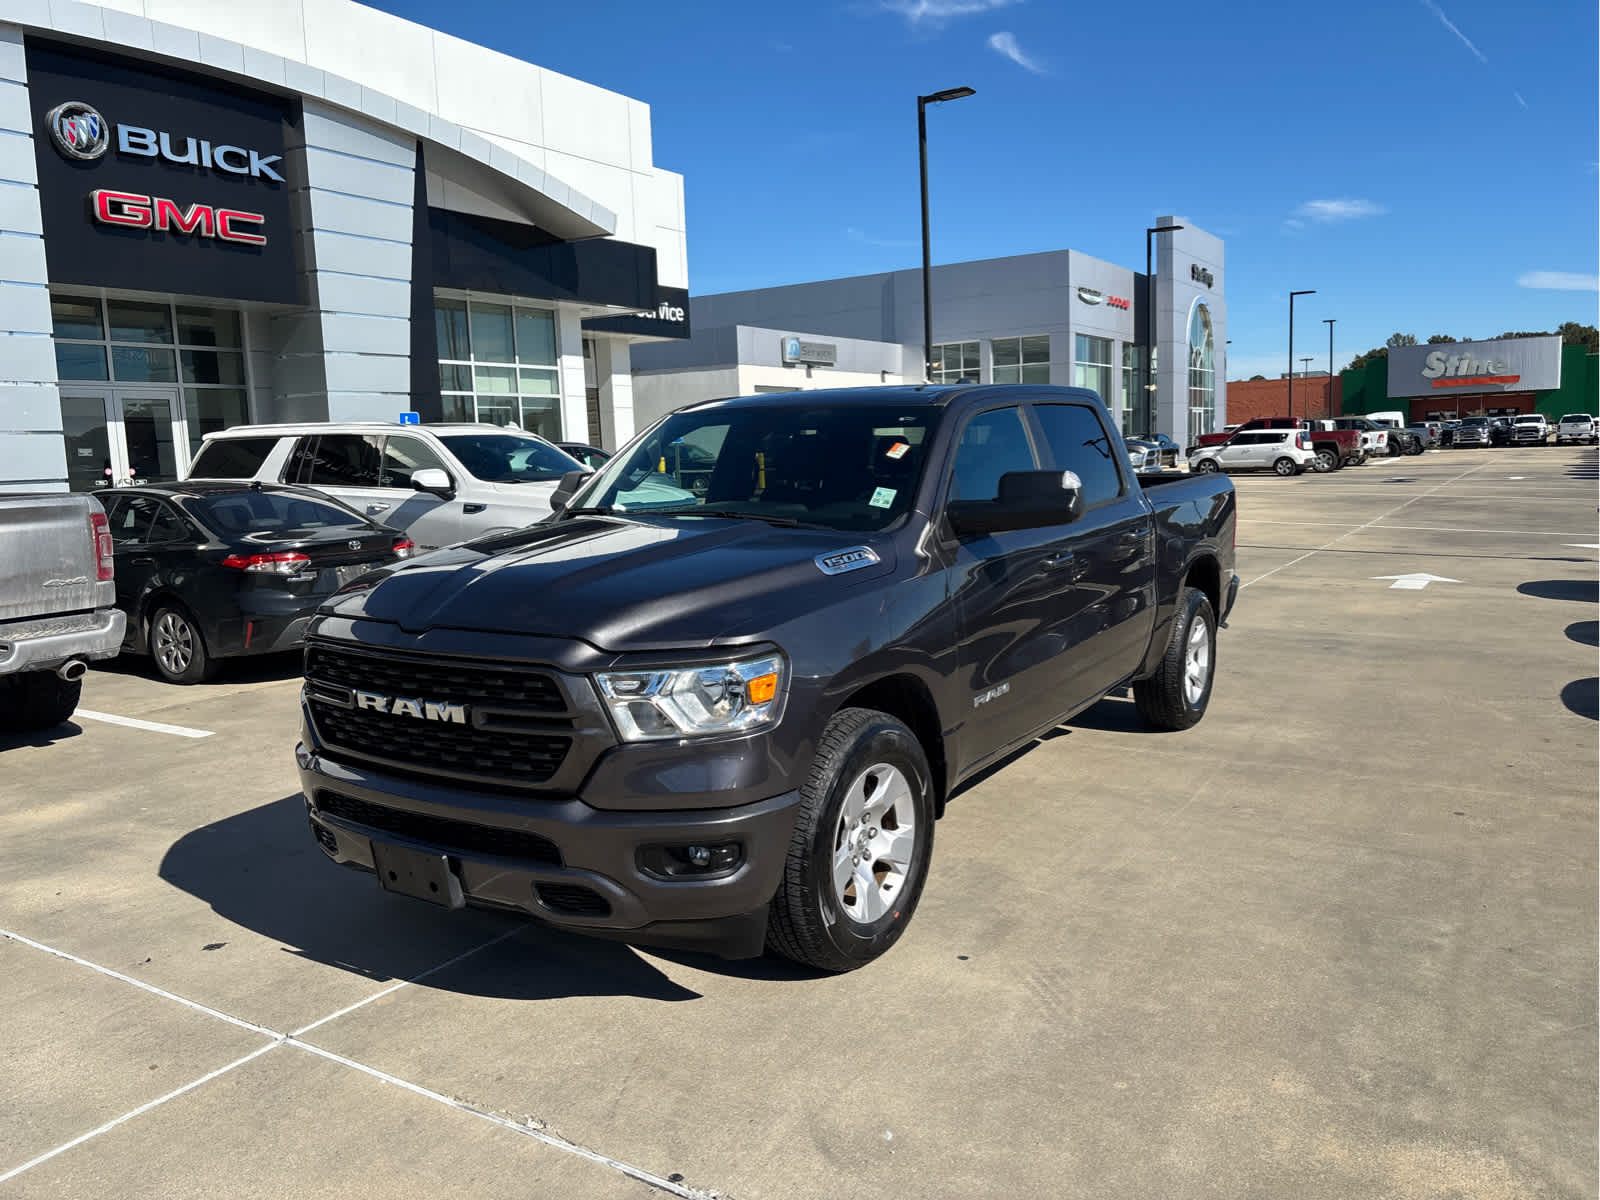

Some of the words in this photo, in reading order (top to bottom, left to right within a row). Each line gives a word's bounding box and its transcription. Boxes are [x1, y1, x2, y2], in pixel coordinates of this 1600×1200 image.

[117, 124, 286, 182] BUICK
[91, 189, 267, 246] GMC
[823, 550, 866, 569] 1500
[357, 689, 466, 725] RAM
